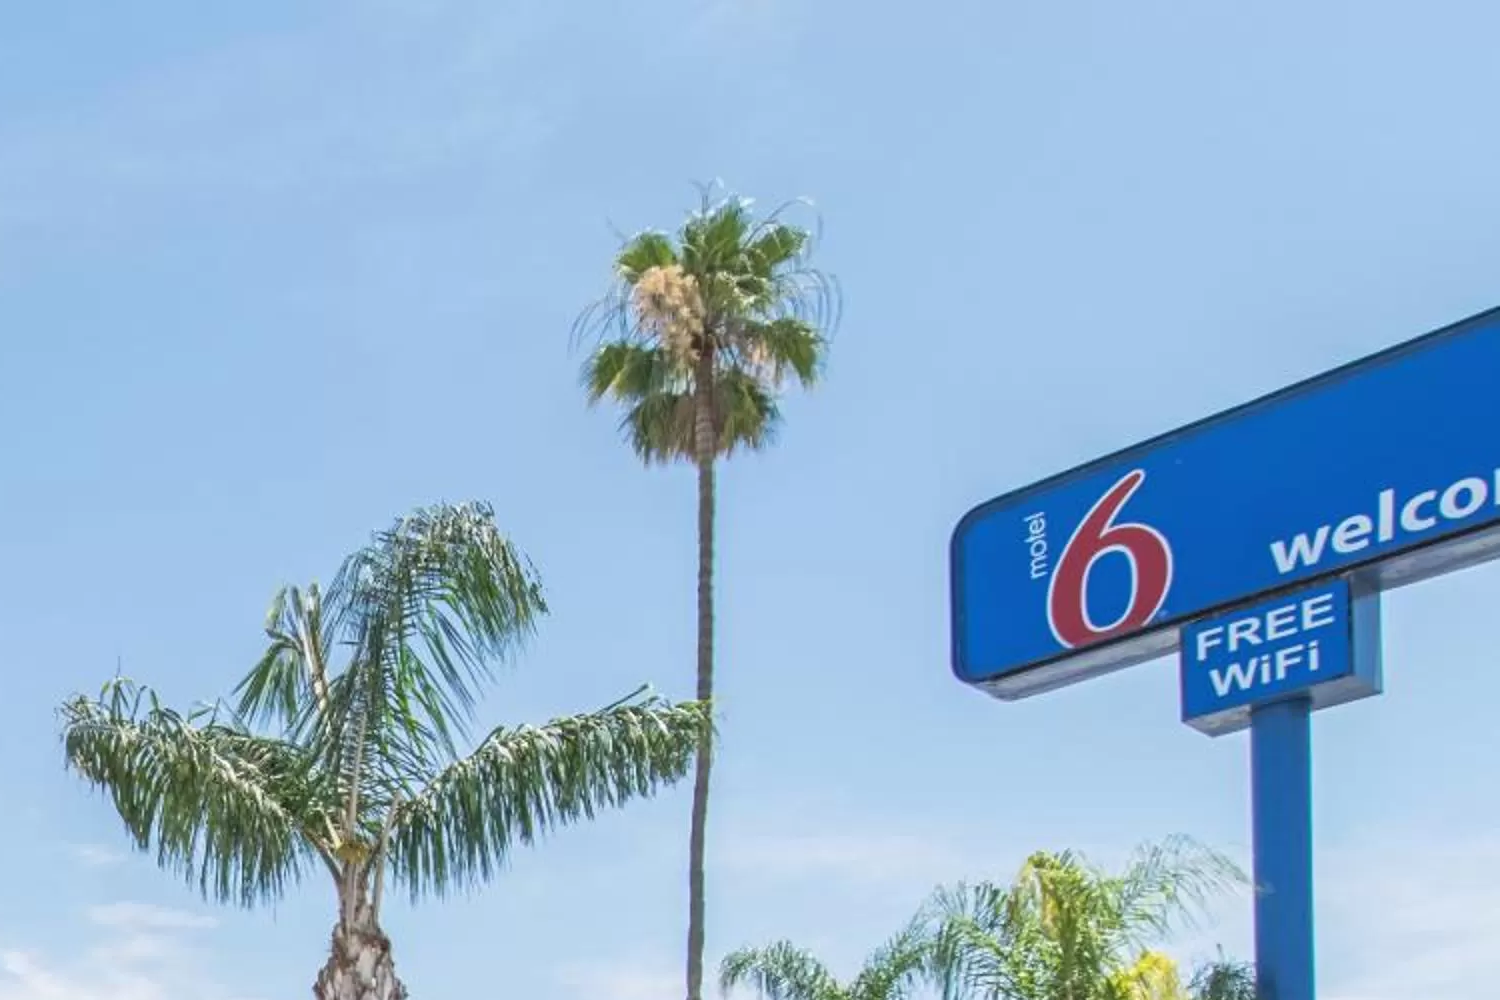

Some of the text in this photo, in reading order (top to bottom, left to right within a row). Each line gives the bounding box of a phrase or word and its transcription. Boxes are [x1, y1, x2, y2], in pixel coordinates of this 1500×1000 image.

[1023, 511, 1049, 580] motel
[1269, 467, 1500, 575] welco
[1046, 468, 1173, 648] 6
[1196, 593, 1335, 661] FREE
[1208, 640, 1320, 698] WiFi
